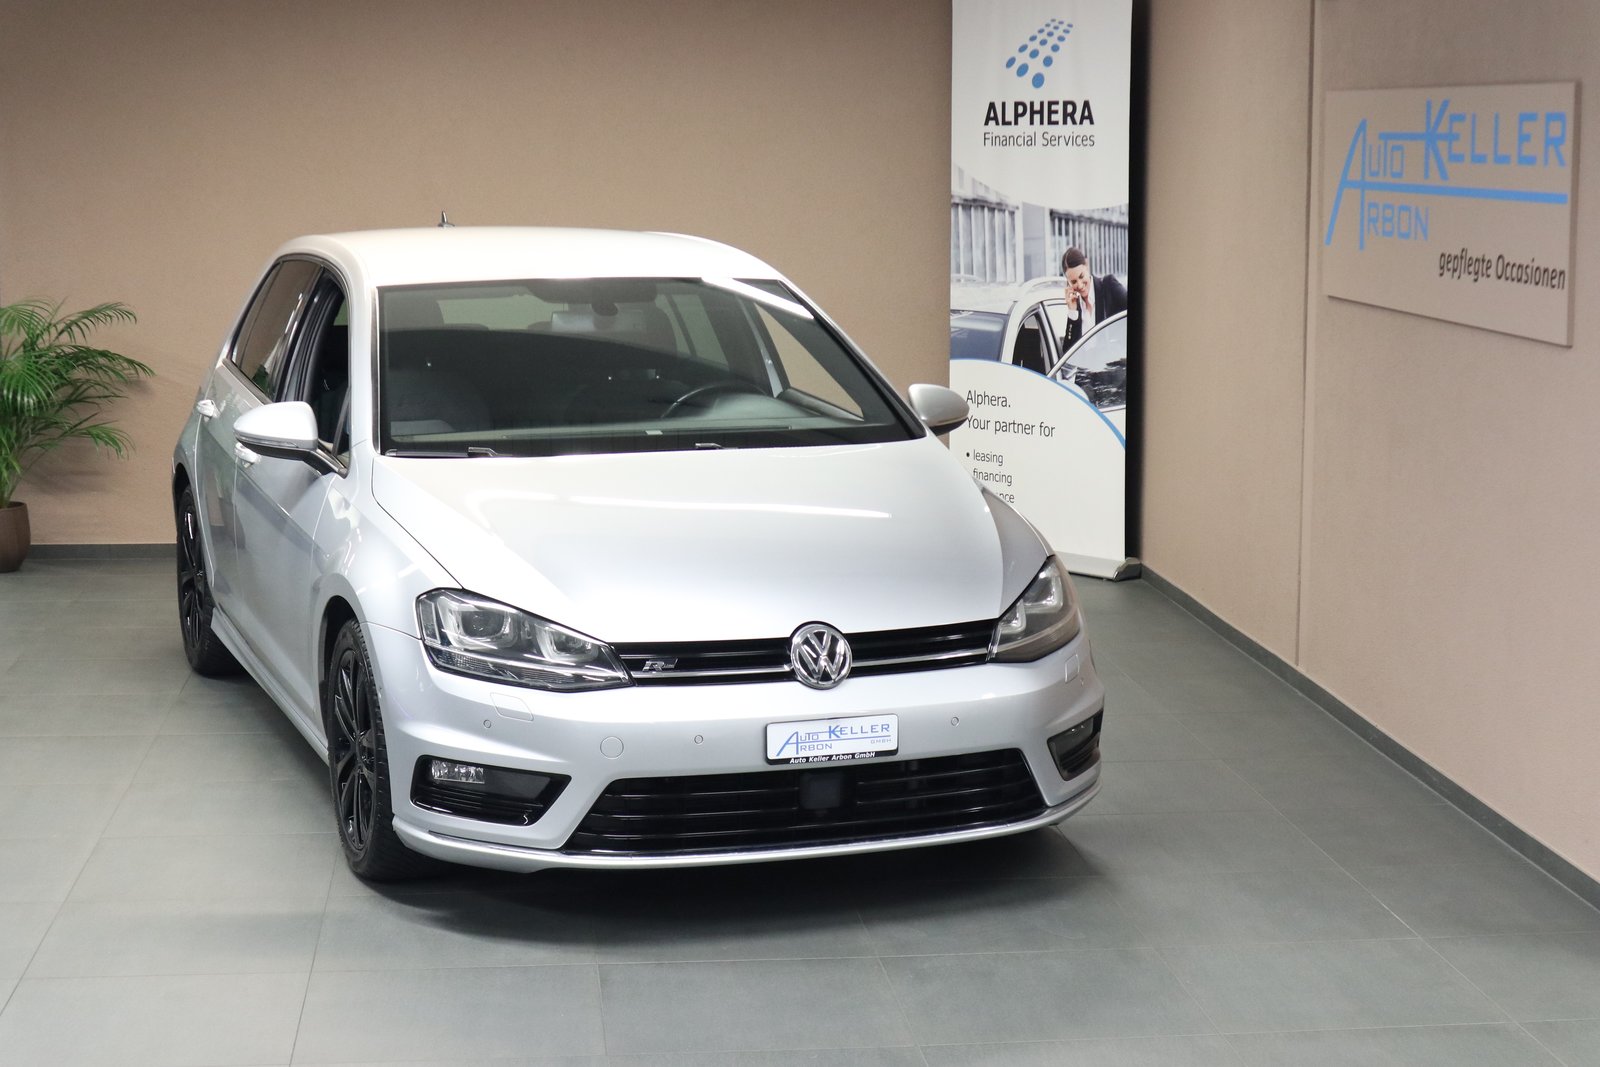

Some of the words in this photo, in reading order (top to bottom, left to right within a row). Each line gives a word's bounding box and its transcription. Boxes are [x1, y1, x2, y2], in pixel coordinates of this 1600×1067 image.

[983, 100, 1095, 126] ALPHERA
[983, 131, 1037, 147] Financial
[1041, 131, 1095, 147] Services
[1423, 98, 1567, 181] KELLER
[1439, 248, 1492, 282] gepflegte
[1496, 254, 1566, 290] Occasionen
[966, 389, 1011, 408] Alphera.
[967, 415, 990, 430] Your
[994, 420, 1035, 435] partner
[1039, 421, 1056, 437] for
[973, 449, 1003, 466] leasing
[973, 468, 1013, 486] financing
[828, 724, 890, 739] KELLER
[808, 755, 829, 763] Keller
[832, 753, 852, 761] Arbon
[854, 751, 876, 759] GmbH
